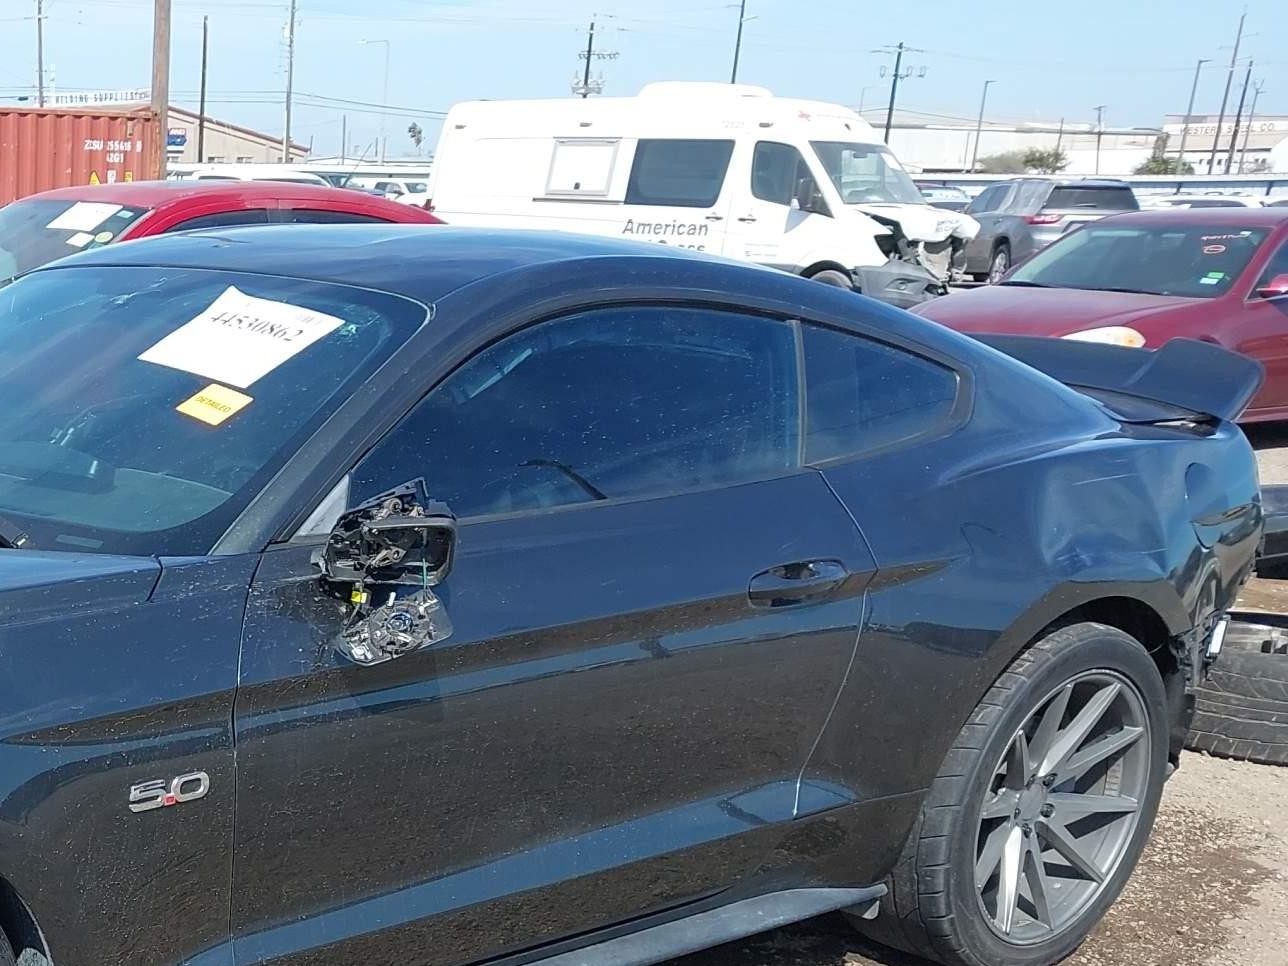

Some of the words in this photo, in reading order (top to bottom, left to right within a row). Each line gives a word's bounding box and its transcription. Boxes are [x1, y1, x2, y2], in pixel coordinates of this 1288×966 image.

[621, 218, 709, 237] American
[209, 311, 305, 342] 44530862
[128, 771, 210, 813] 5.0
